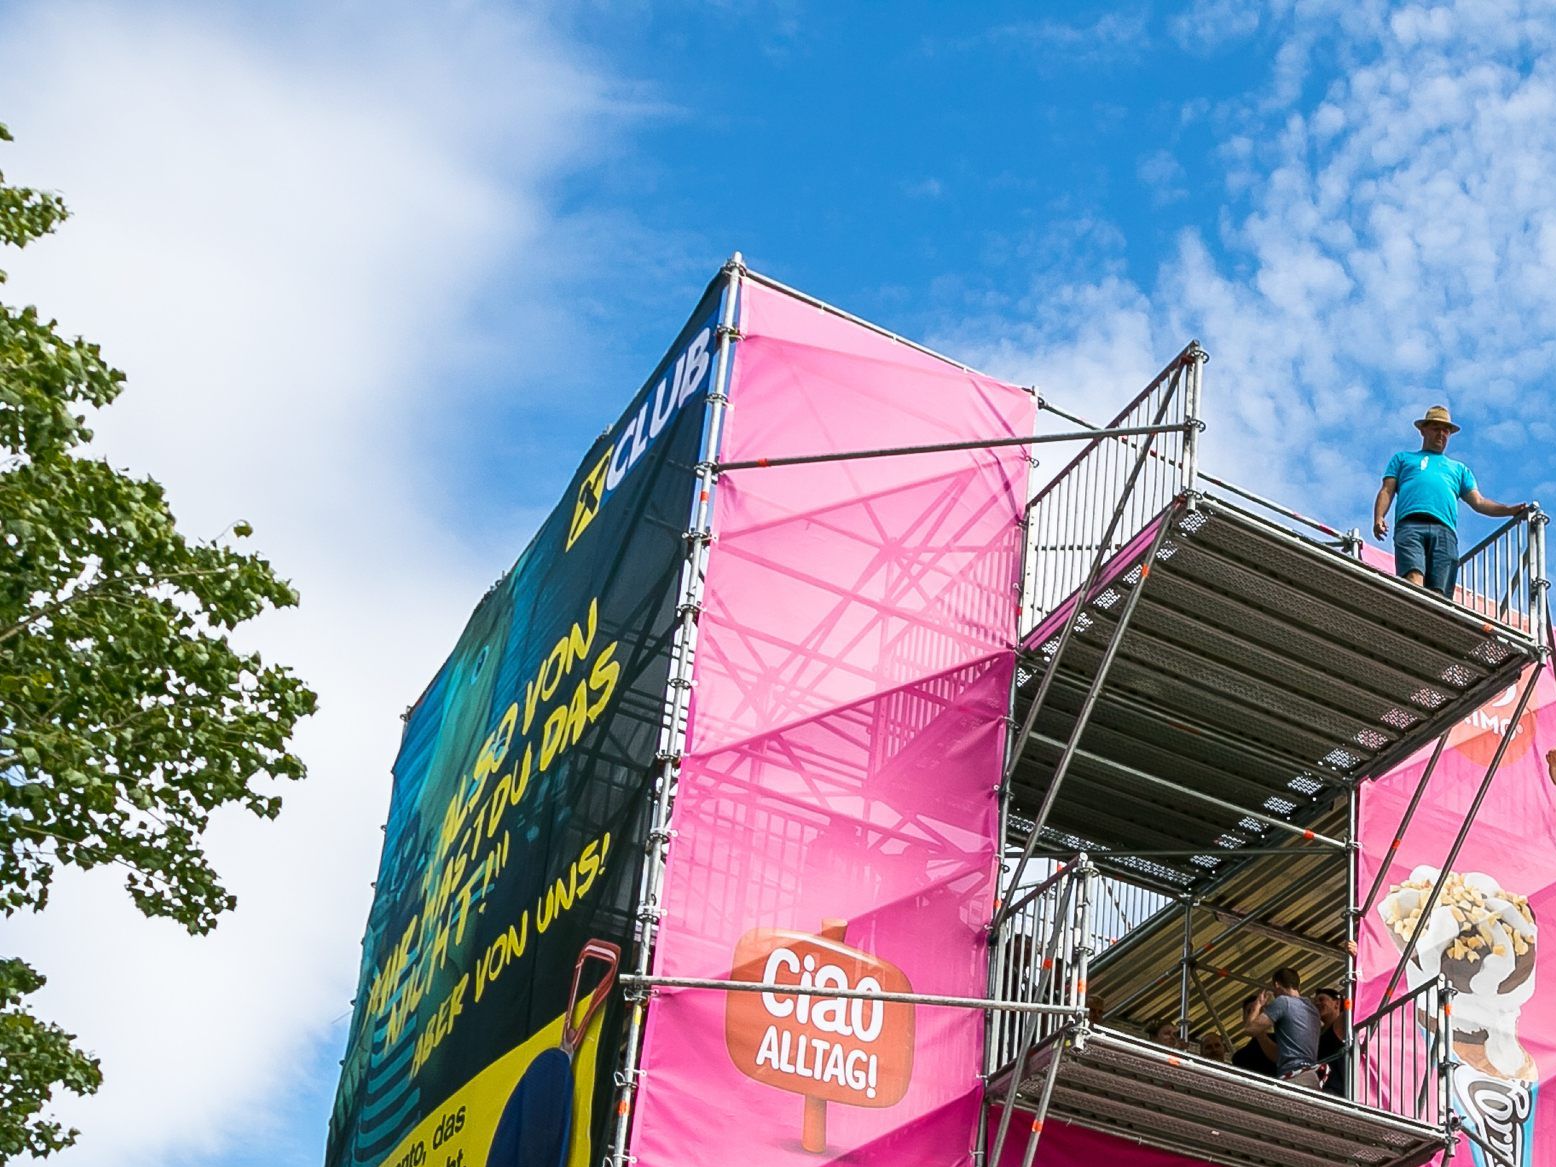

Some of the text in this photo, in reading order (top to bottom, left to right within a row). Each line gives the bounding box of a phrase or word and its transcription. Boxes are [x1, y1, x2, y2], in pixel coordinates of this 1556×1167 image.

[606, 327, 711, 492] CLUB
[522, 597, 598, 735] VON
[487, 741, 532, 838] DU
[540, 641, 621, 771] DAS
[408, 832, 610, 1079] ABER VON UNS!
[762, 948, 884, 1043] Ciao
[432, 1105, 467, 1151] das
[756, 1025, 878, 1099] ALLTAG!
